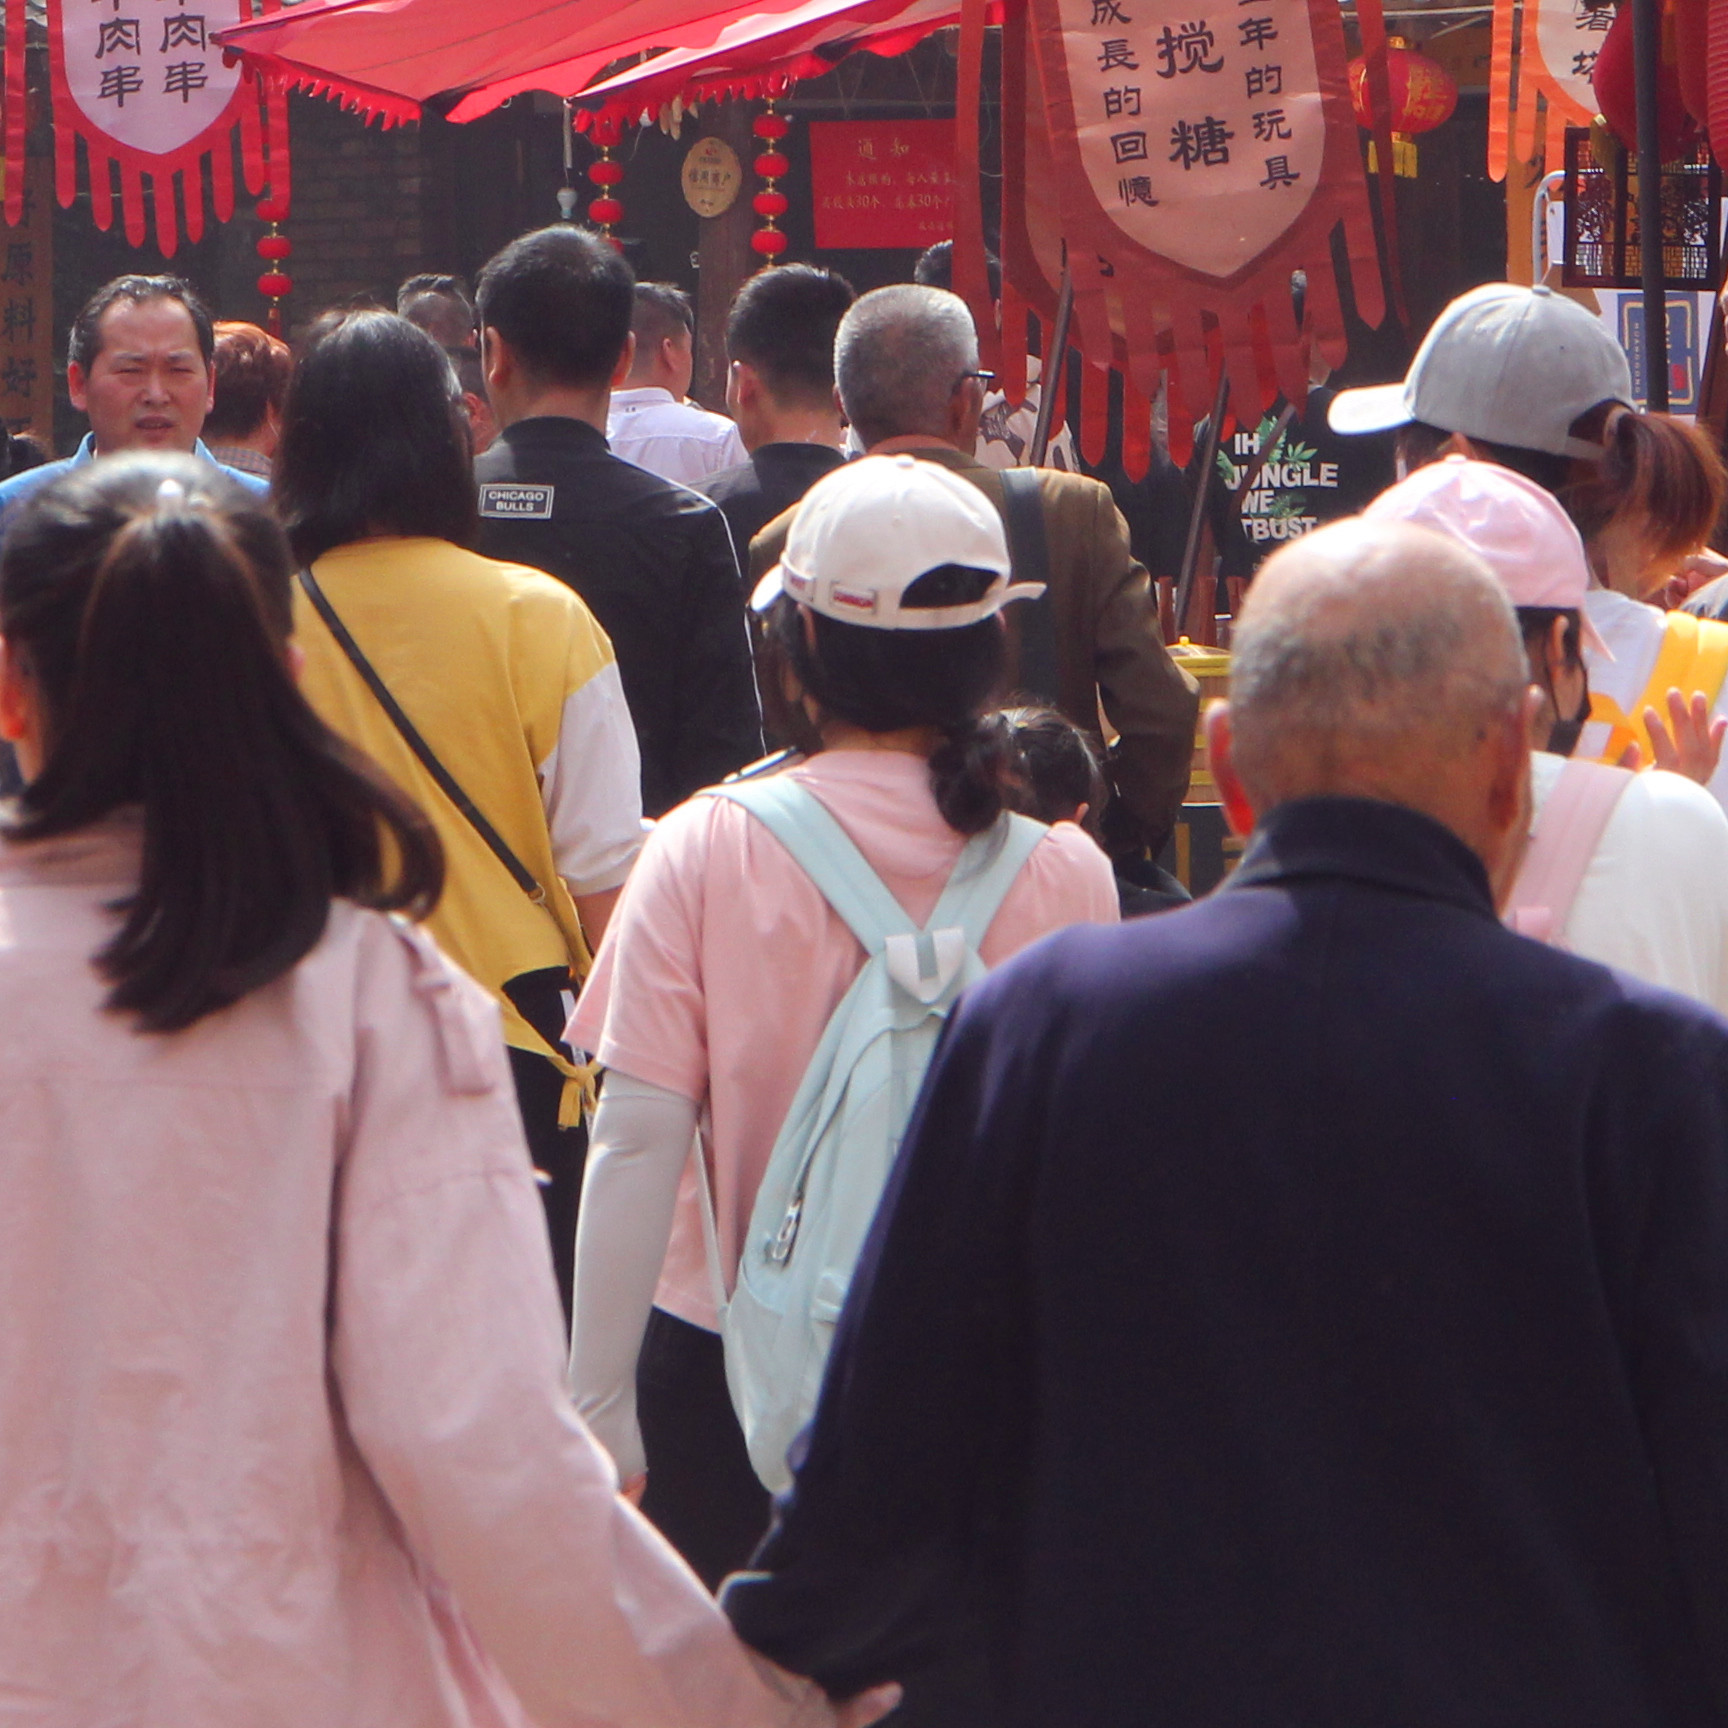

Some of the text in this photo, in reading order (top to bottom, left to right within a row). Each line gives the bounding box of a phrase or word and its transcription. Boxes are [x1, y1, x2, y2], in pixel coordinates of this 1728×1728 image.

[1, 186, 38, 428] 原料好
[487, 489, 545, 503] CHICAGO
[1241, 489, 1277, 514] WE
[495, 500, 535, 513] BULLS
